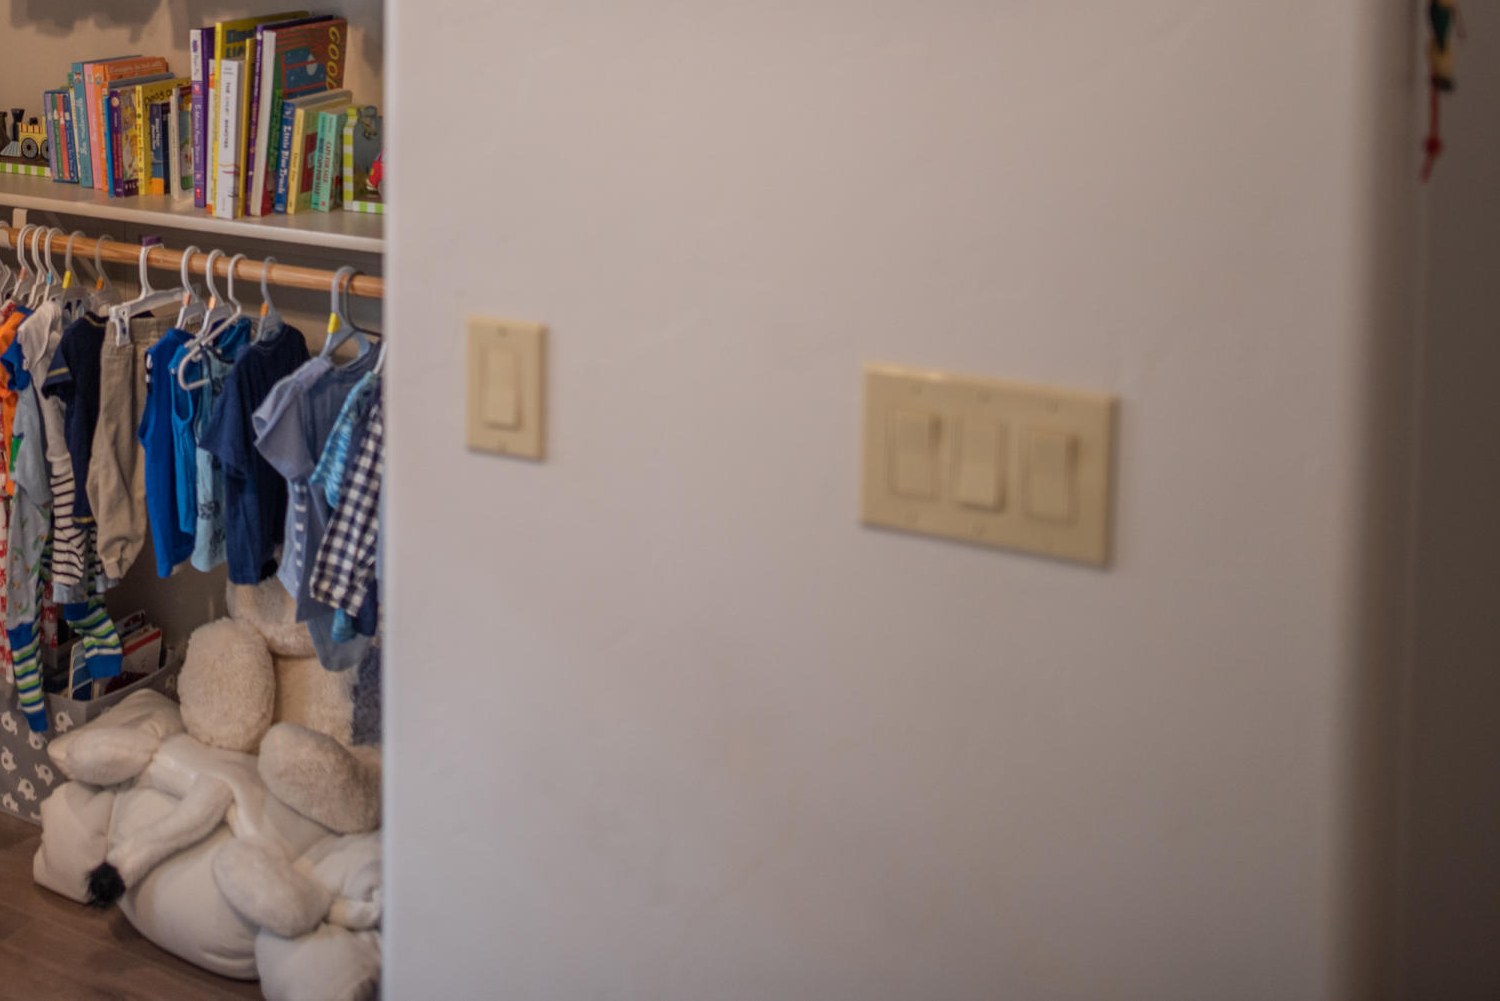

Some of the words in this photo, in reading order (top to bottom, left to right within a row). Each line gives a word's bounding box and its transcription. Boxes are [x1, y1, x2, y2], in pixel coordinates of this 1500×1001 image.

[283, 125, 292, 149] Little
[280, 150, 290, 168] Blue
[277, 168, 289, 194] Truck
